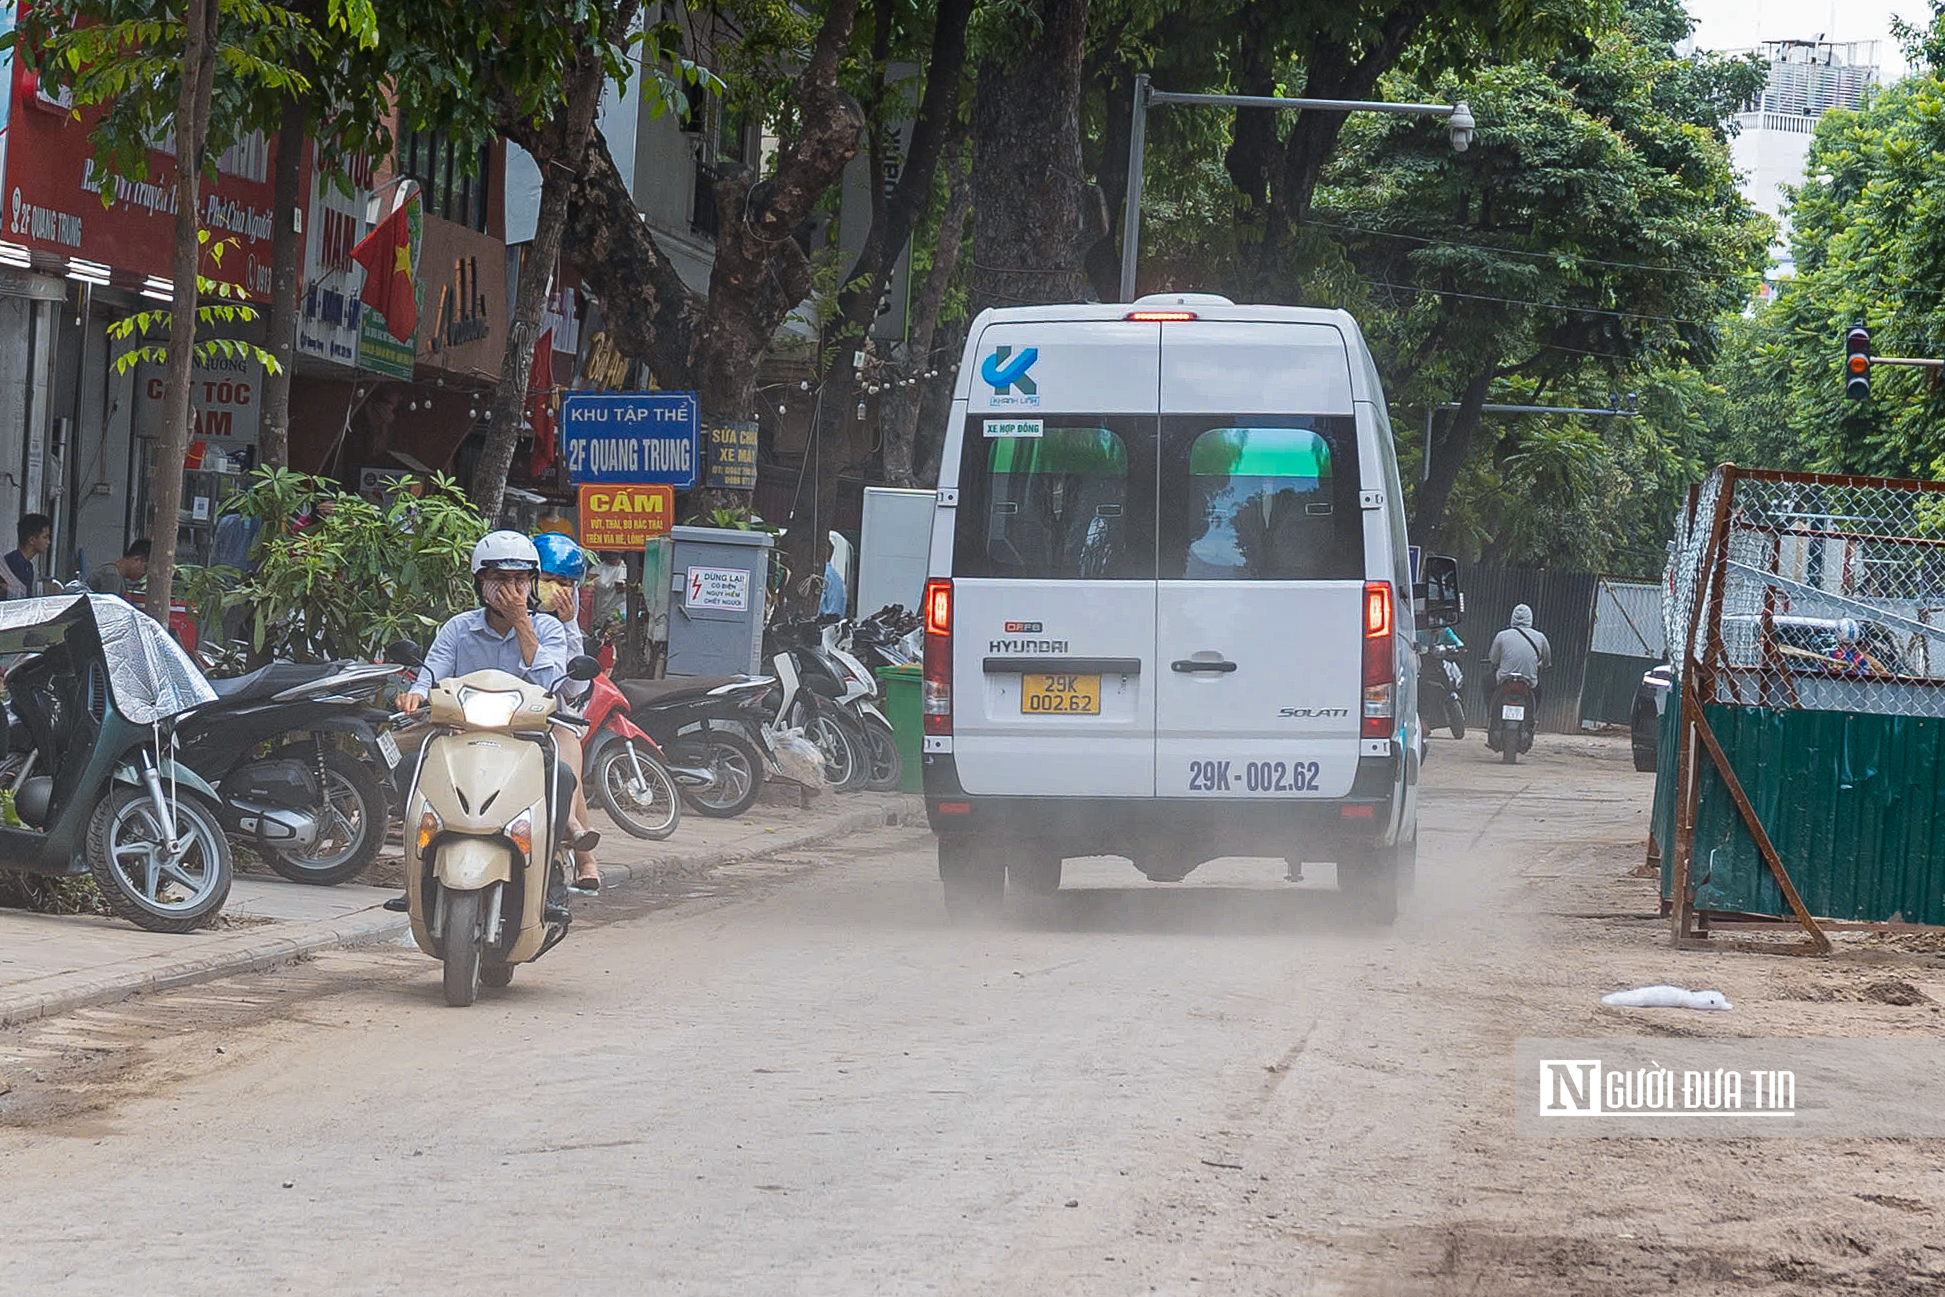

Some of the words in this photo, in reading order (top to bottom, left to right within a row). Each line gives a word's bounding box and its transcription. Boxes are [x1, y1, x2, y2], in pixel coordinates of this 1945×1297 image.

[20, 203, 31, 235] 2F
[31, 205, 57, 241] QUANG
[57, 212, 82, 248] TRUNG
[203, 378, 251, 405] TÓC
[571, 408, 608, 422] KHU
[614, 405, 648, 425] TẬP
[654, 402, 689, 422] THỂ
[712, 426, 737, 444] SỬA
[987, 424, 998, 433] XE
[999, 422, 1015, 434] HỢP
[1017, 422, 1040, 433] ĐỒNG
[569, 438, 586, 471] 2F
[590, 438, 638, 475] QUANG
[643, 438, 690, 471] TRUNG
[719, 448, 735, 462] XE
[589, 488, 664, 513] CẤM
[989, 640, 1069, 653] HYUNDAI
[1044, 675, 1078, 693] 29K
[1030, 694, 1092, 711] 002.62
[1277, 707, 1349, 719] SOLATI
